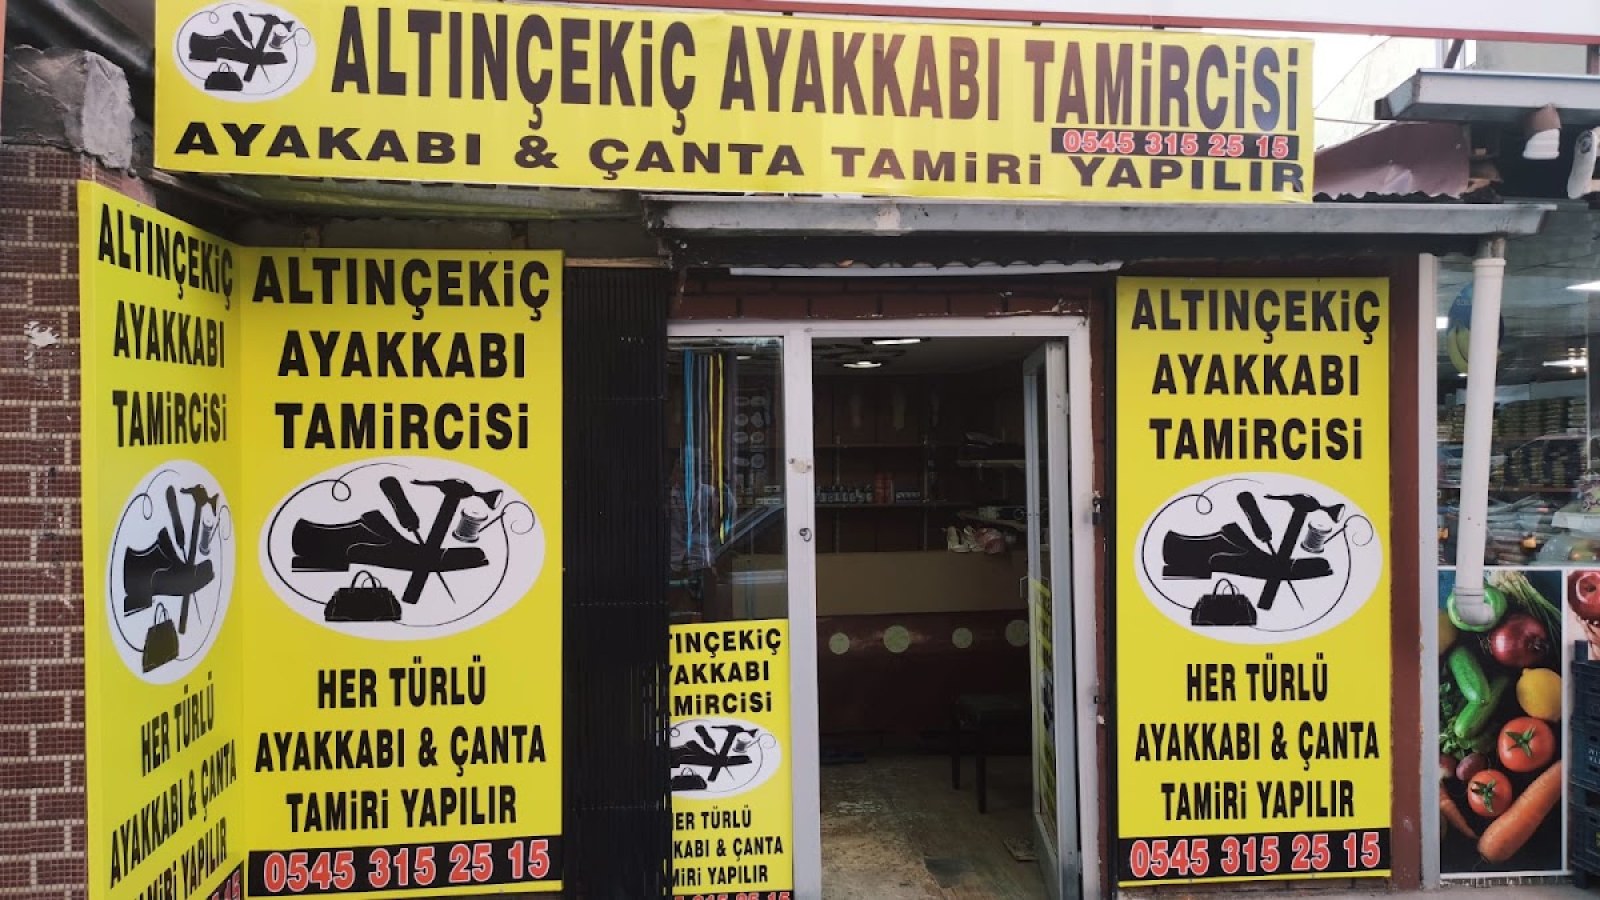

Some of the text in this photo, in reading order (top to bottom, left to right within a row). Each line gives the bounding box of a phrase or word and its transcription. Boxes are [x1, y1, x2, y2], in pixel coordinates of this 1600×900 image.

[720, 26, 999, 121] AYAKKABI
[174, 121, 481, 165] AYAKABI
[515, 135, 559, 169] &
[589, 139, 804, 181] ÇANTA
[1069, 156, 1304, 193] YAPILIR
[1063, 129, 1289, 159] 0545 315 25 15
[113, 299, 225, 369] AYAKKABI
[278, 330, 525, 378] AYAKKABI
[1152, 354, 1359, 396] AYAKKABI
[670, 628, 781, 658] INÇEKiÇ
[318, 655, 485, 708] HER TÜRLÜ
[670, 660, 769, 686] AKKABI
[1187, 652, 1328, 702] HER TÜRLÜ
[141, 671, 214, 777] HER TÜRLÜ
[670, 691, 772, 717] MiRCiSi
[255, 725, 546, 777] AYAKKABI & ÇANTA
[1135, 721, 1380, 771] AYAKKABI & ÇANTA
[110, 739, 237, 889] AYAKKABI & ÇANTA
[401, 785, 517, 828] YAPILIR
[672, 804, 752, 831] ER TÜRLÜ
[1257, 780, 1355, 819] YAPILIR
[181, 817, 228, 900] YAPILIR
[264, 839, 550, 892] 0545 315 25 15
[673, 835, 784, 862] KABI & ÇANTA
[1130, 832, 1380, 877] 0545 315 25 15
[672, 864, 768, 888] MiRi YAPILIR
